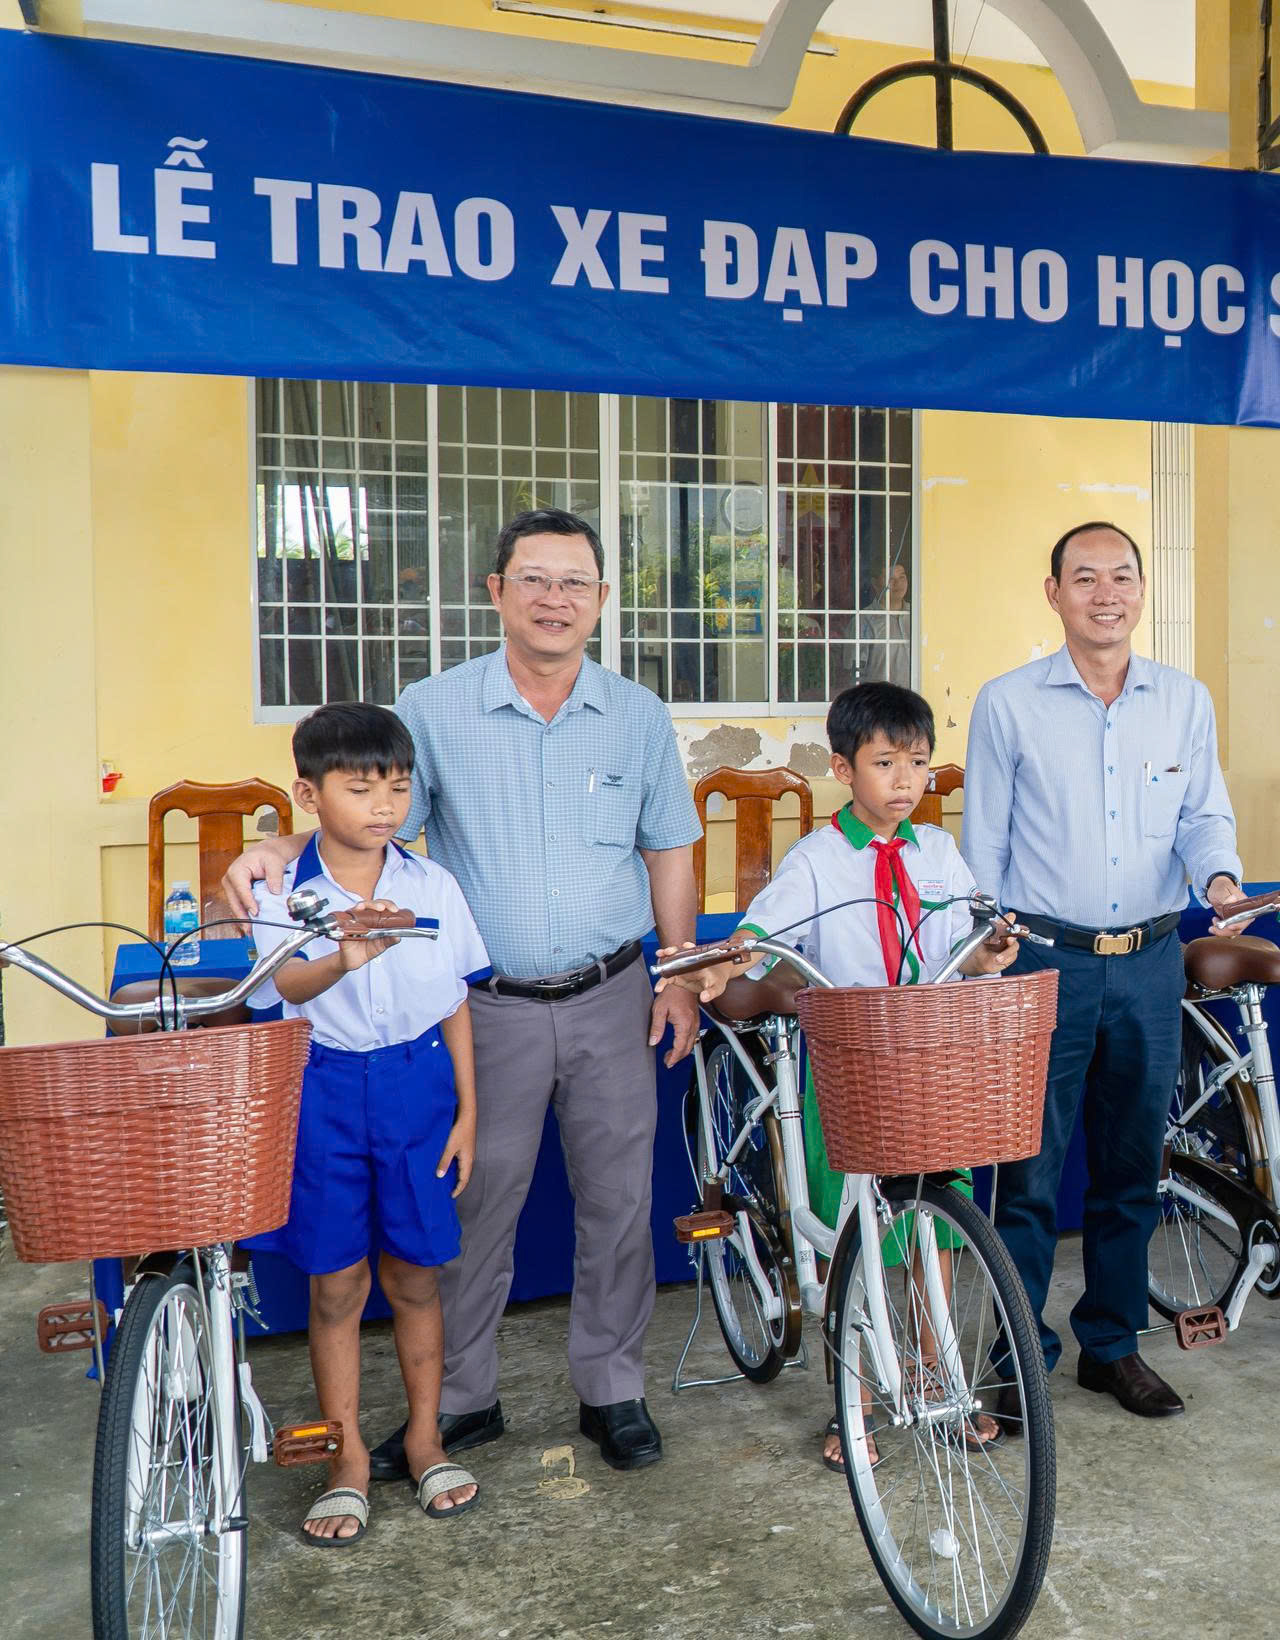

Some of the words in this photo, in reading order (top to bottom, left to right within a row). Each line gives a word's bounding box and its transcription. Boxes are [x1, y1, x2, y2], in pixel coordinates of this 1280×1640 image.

[92, 137, 215, 259] LỄ
[254, 178, 515, 281] TRAO
[550, 205, 669, 294] XE
[700, 220, 878, 322] ĐẠP
[909, 239, 1068, 323] CHO
[1098, 255, 1245, 348] HỌC
